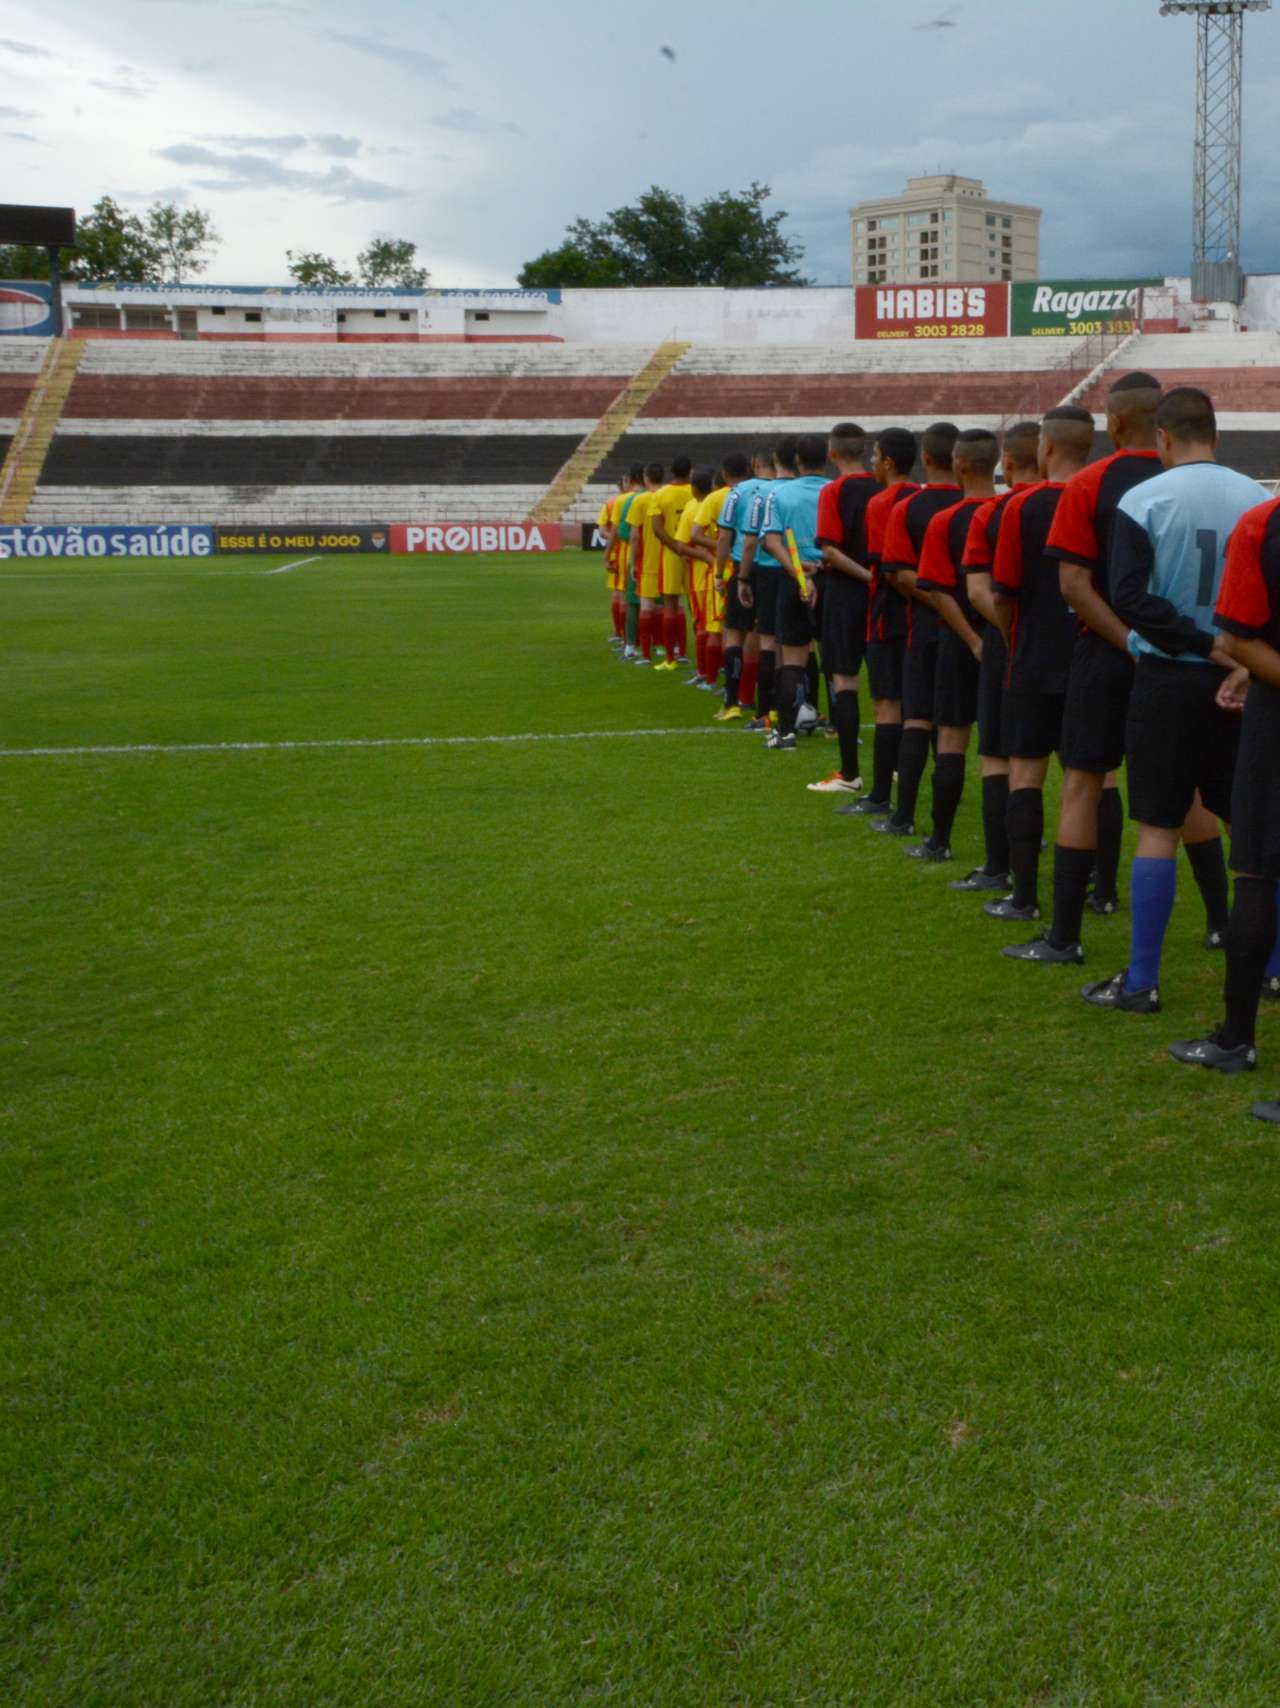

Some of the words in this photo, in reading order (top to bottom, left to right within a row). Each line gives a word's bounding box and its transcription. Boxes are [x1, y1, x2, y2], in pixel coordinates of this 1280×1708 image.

[876, 287, 986, 320] HABIB'S
[914, 325, 947, 337] 3003
[950, 324, 985, 337] 2828
[1032, 327, 1065, 337] DELIVERY
[1068, 321, 1102, 335] 3003
[110, 526, 211, 557] saúde
[220, 536, 255, 548] ESSE
[258, 533, 267, 548] É
[269, 536, 282, 547] O
[285, 535, 315, 548] MEU
[318, 535, 361, 547] JOGO
